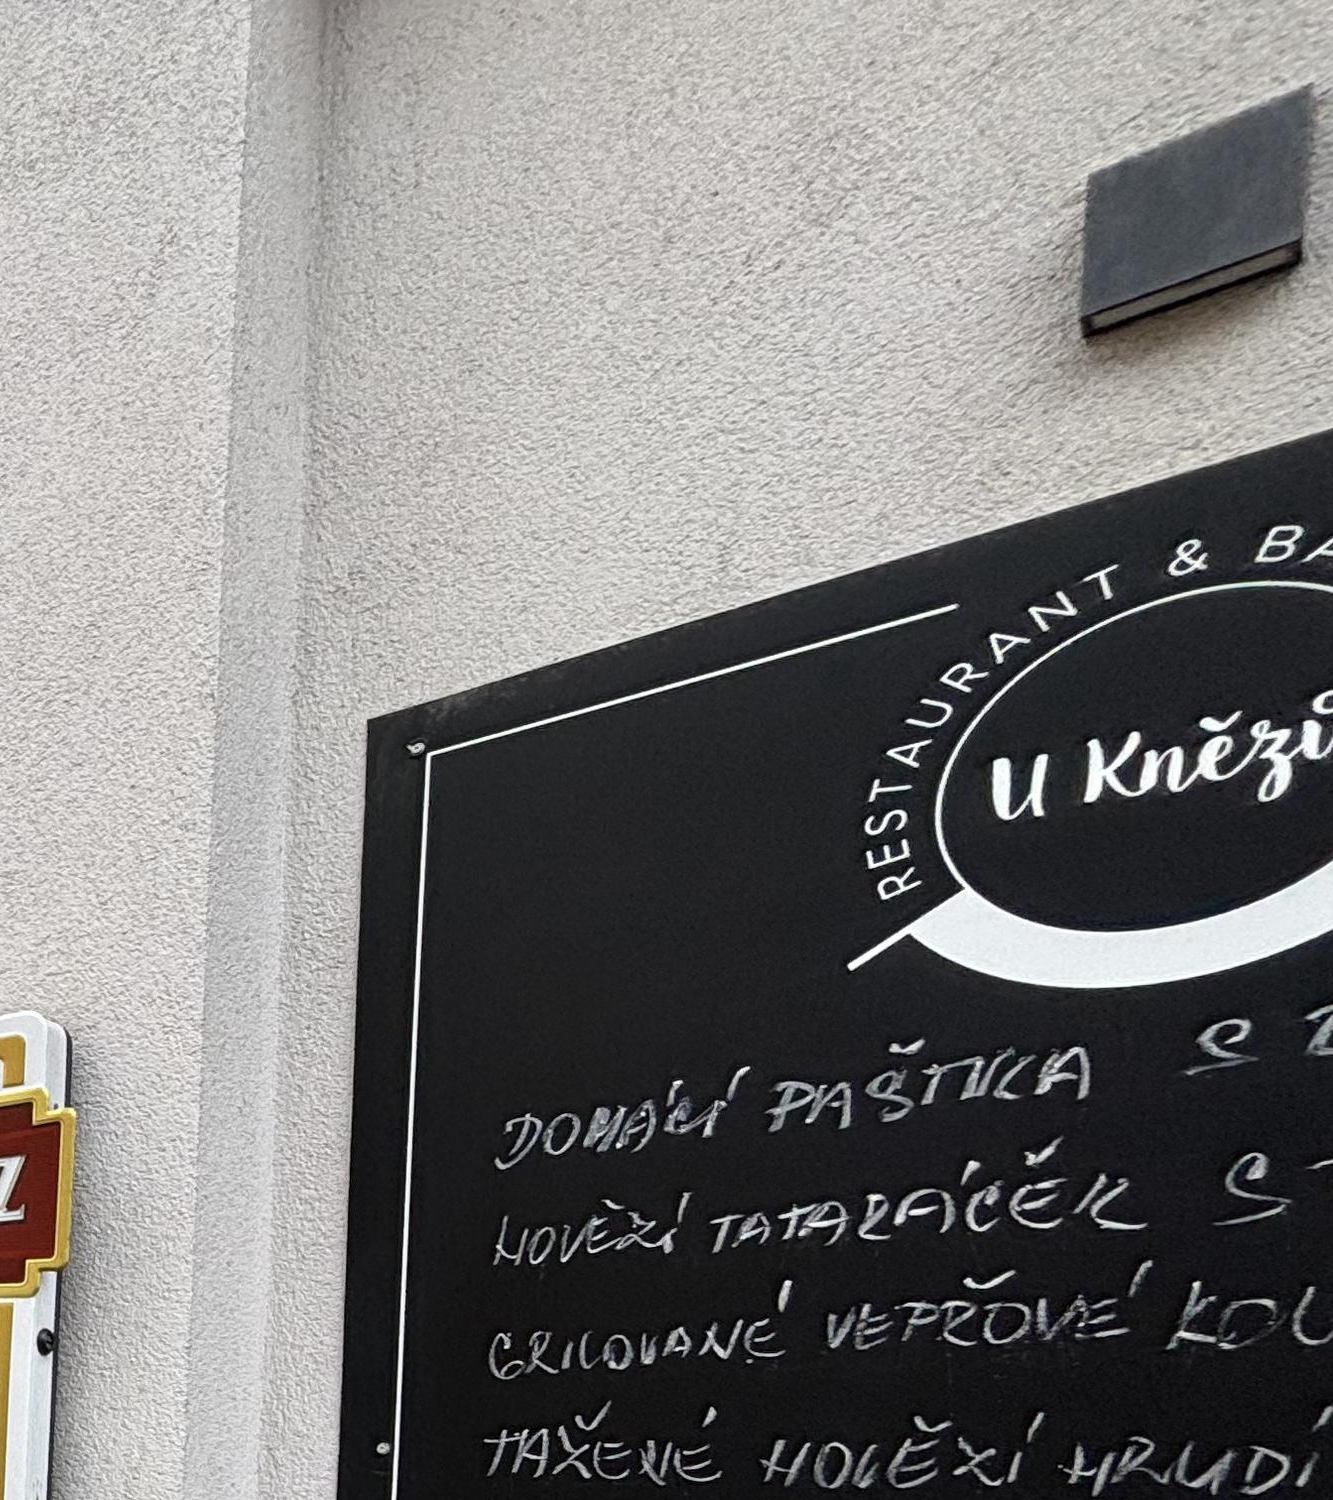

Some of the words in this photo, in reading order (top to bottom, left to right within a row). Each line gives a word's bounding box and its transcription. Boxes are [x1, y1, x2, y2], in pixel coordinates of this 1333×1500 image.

[864, 563, 1121, 901] RESTAURANT
[1167, 538, 1210, 577] &
[991, 752, 1050, 822] U
